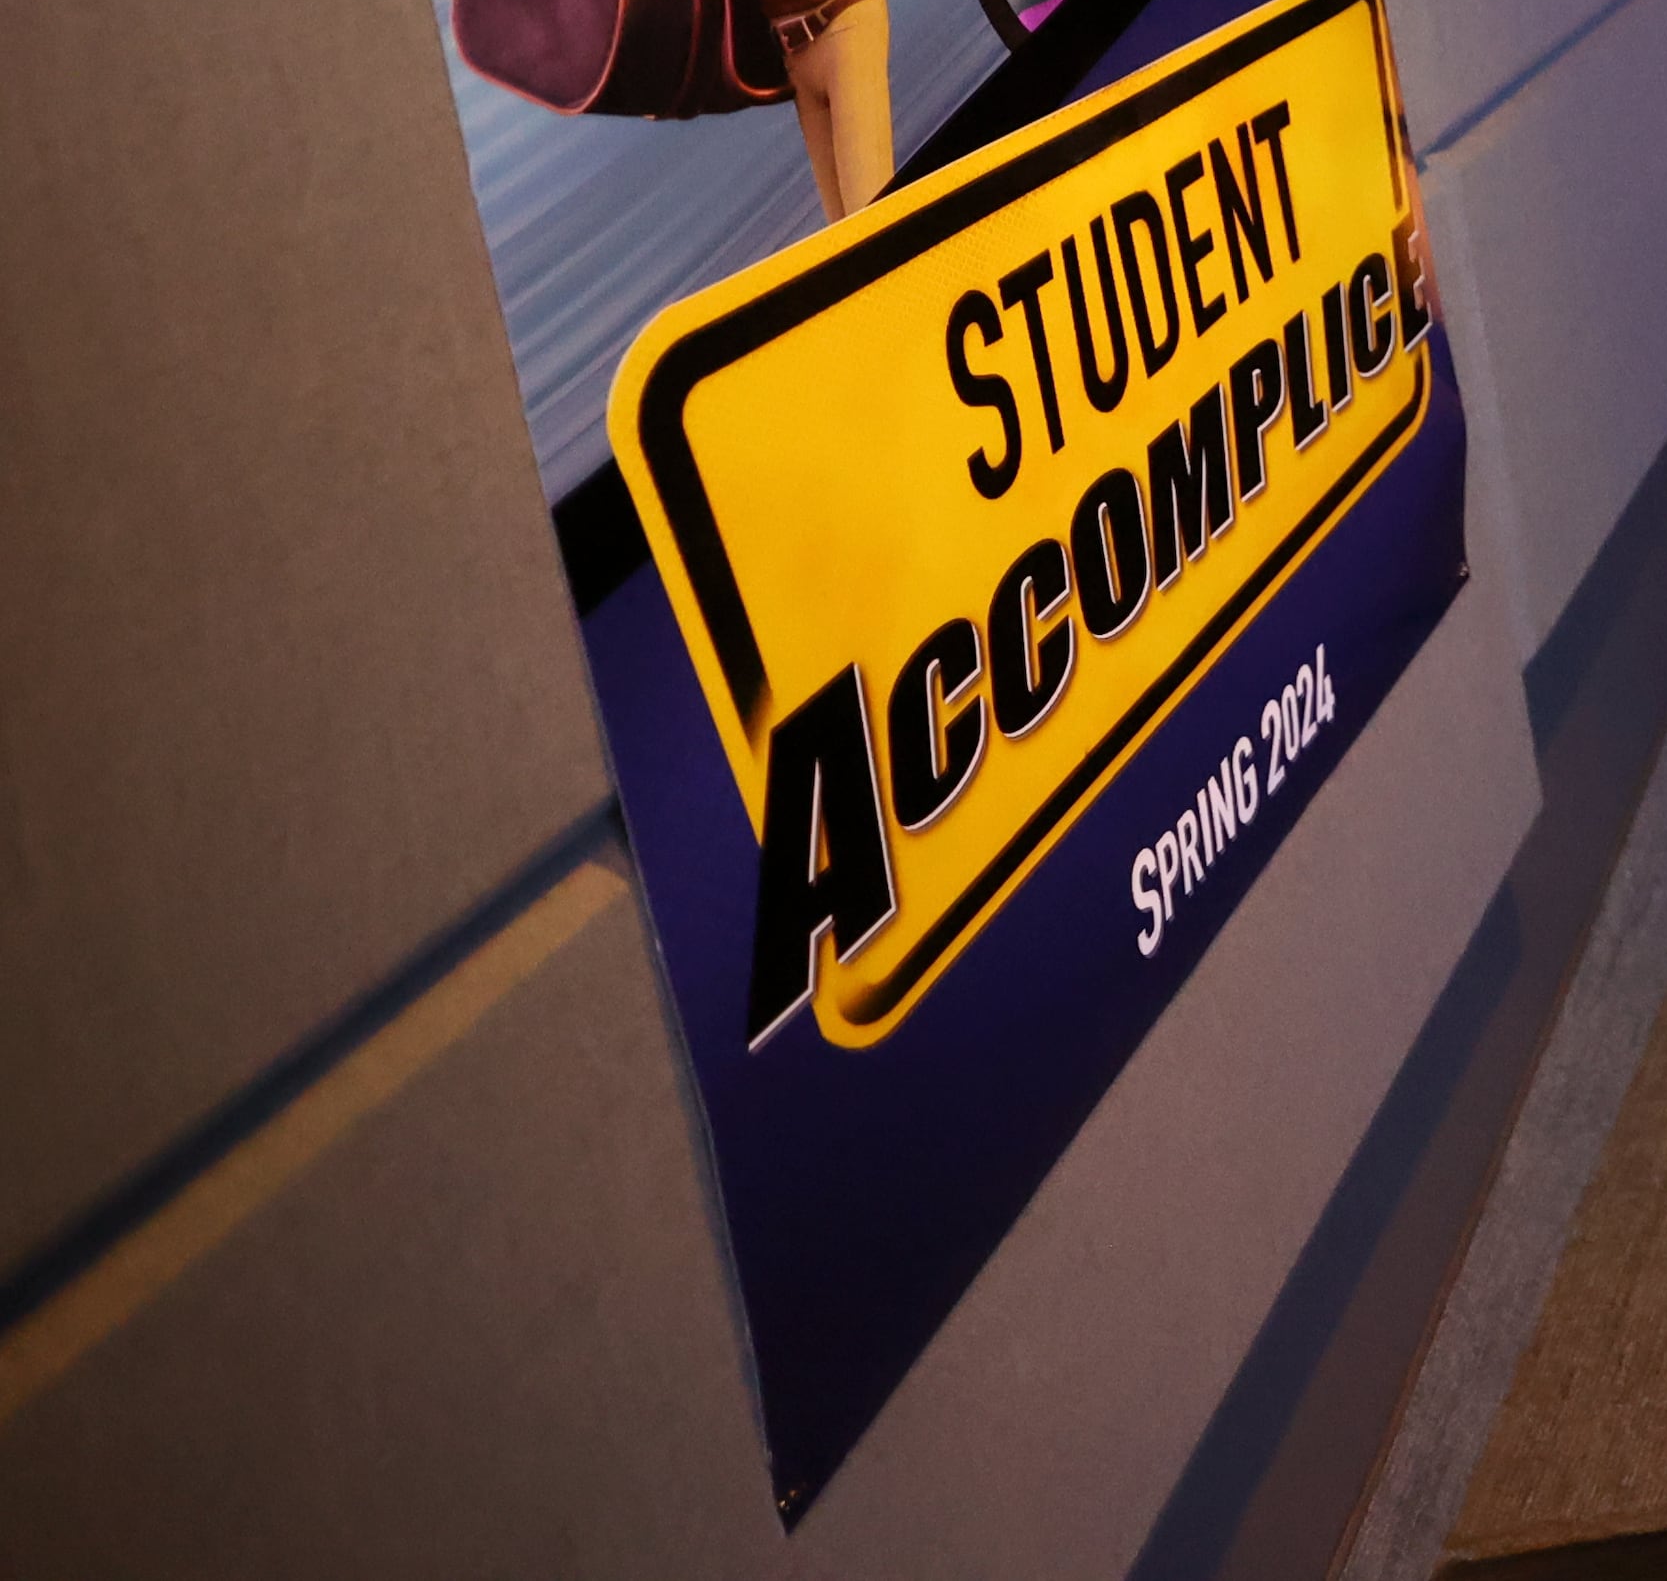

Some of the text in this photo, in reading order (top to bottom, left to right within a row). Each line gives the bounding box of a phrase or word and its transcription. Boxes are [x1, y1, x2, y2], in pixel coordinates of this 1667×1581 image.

[945, 100, 1304, 501] STUDENT
[745, 213, 1434, 1053] ACCOMPLICE
[1130, 642, 1337, 958] SPRING 2024
